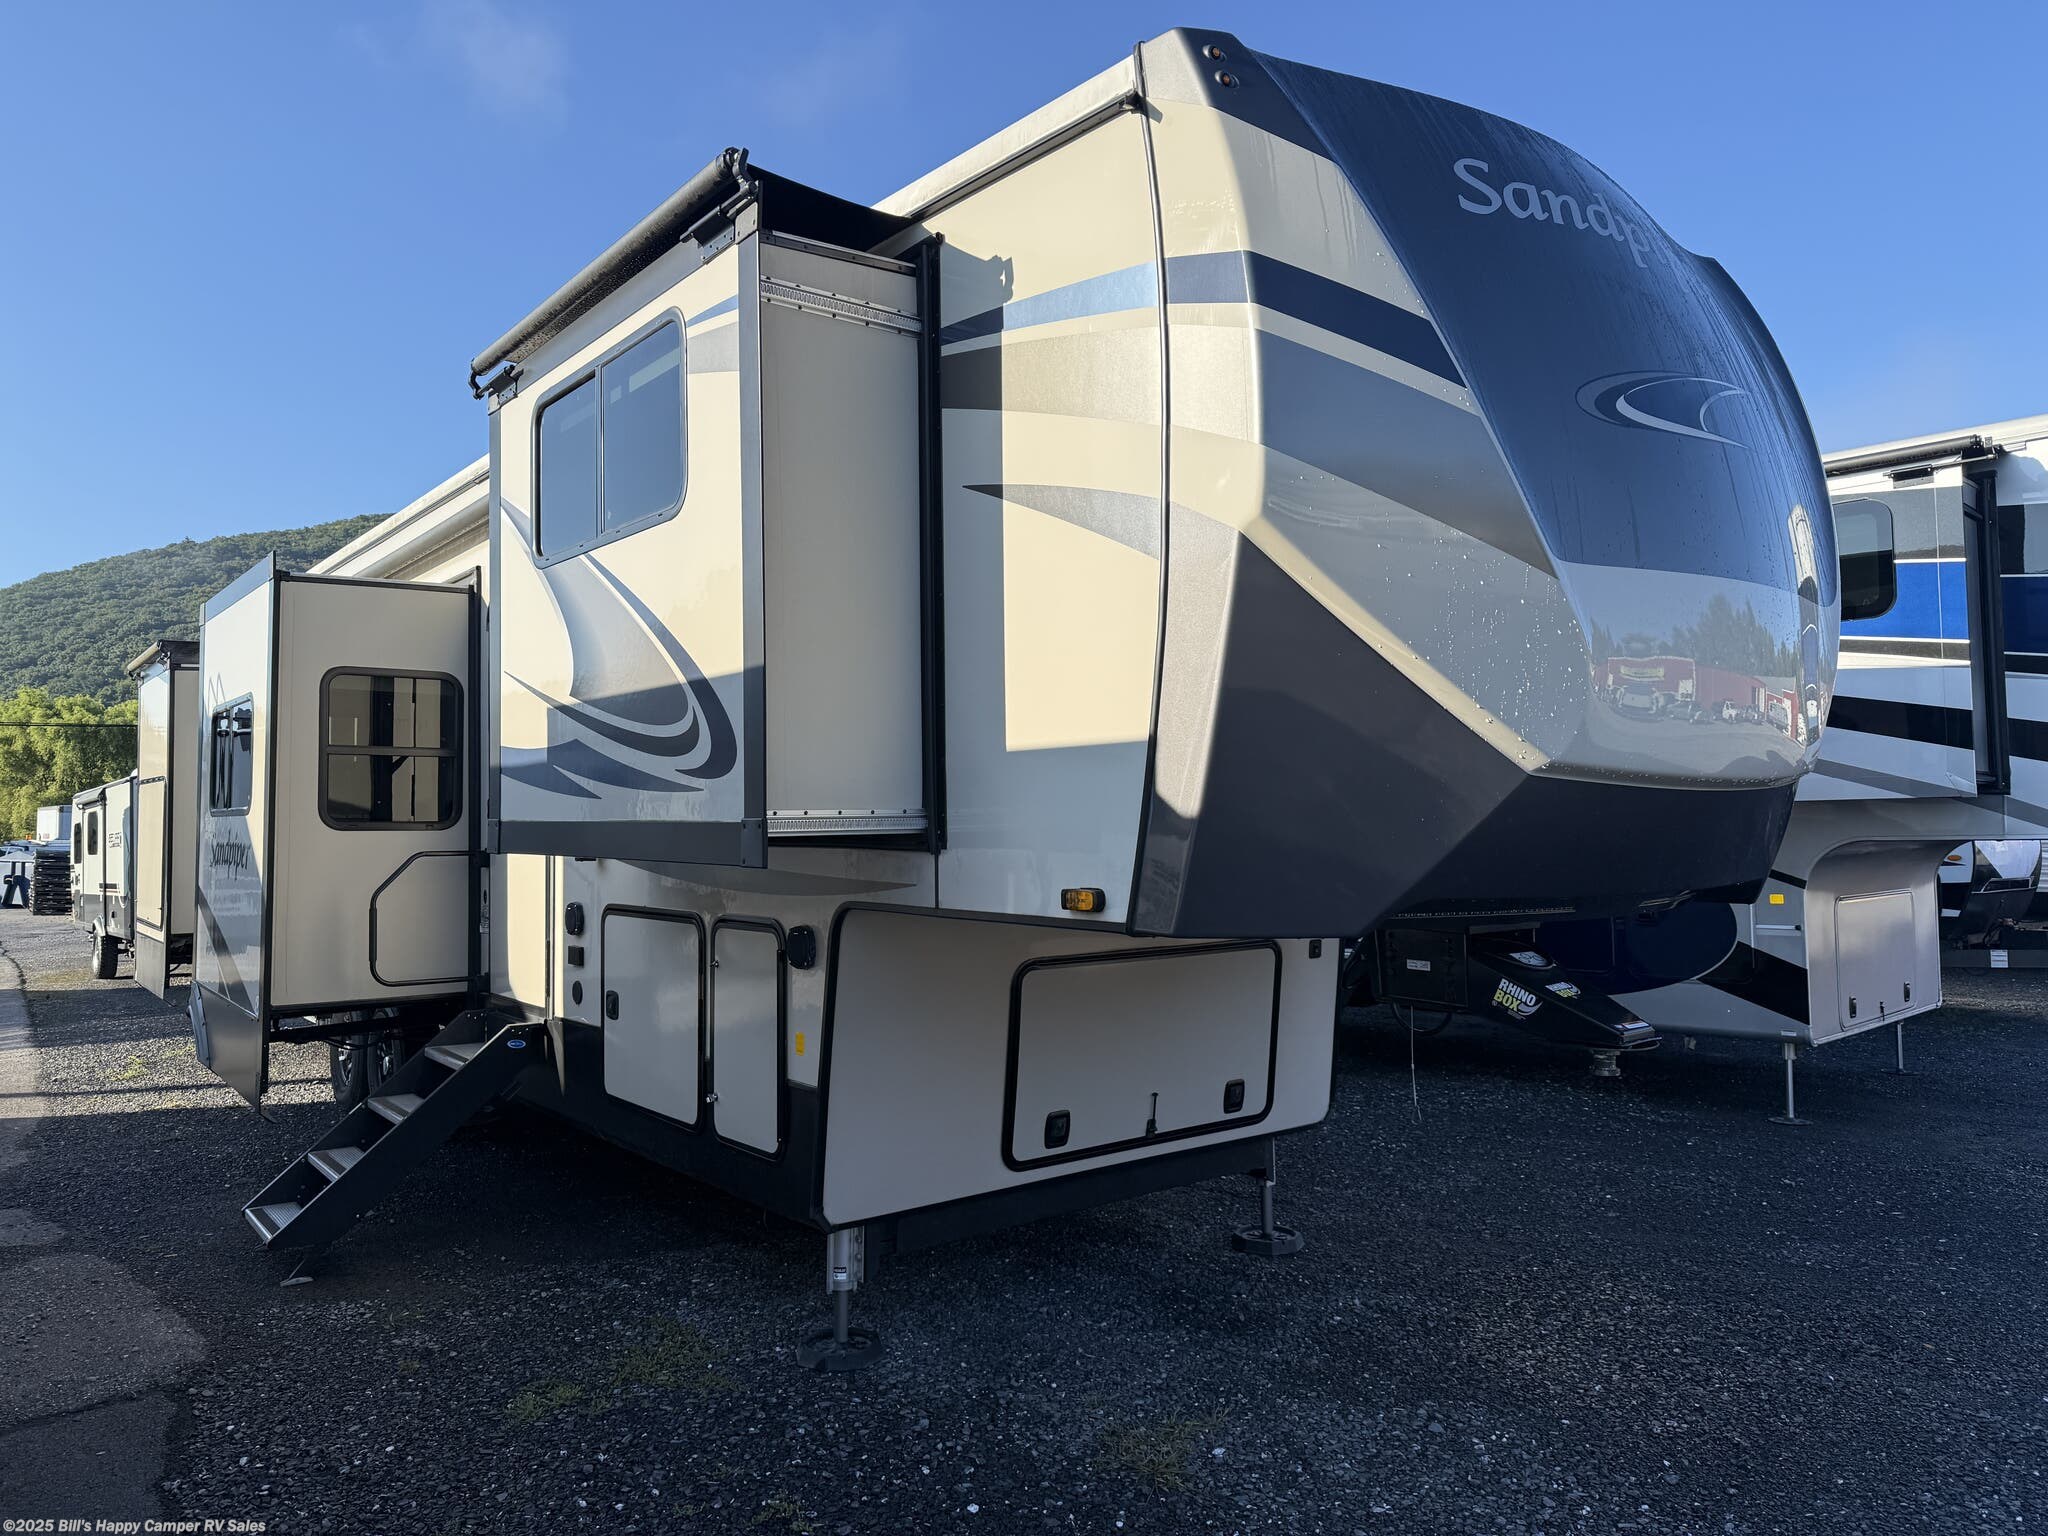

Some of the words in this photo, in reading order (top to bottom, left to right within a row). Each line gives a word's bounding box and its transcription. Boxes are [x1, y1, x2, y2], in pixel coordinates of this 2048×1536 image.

[1453, 157, 1652, 268] Sandp
[1493, 989, 1521, 1012] BOX
[1499, 978, 1537, 1006] RHINO
